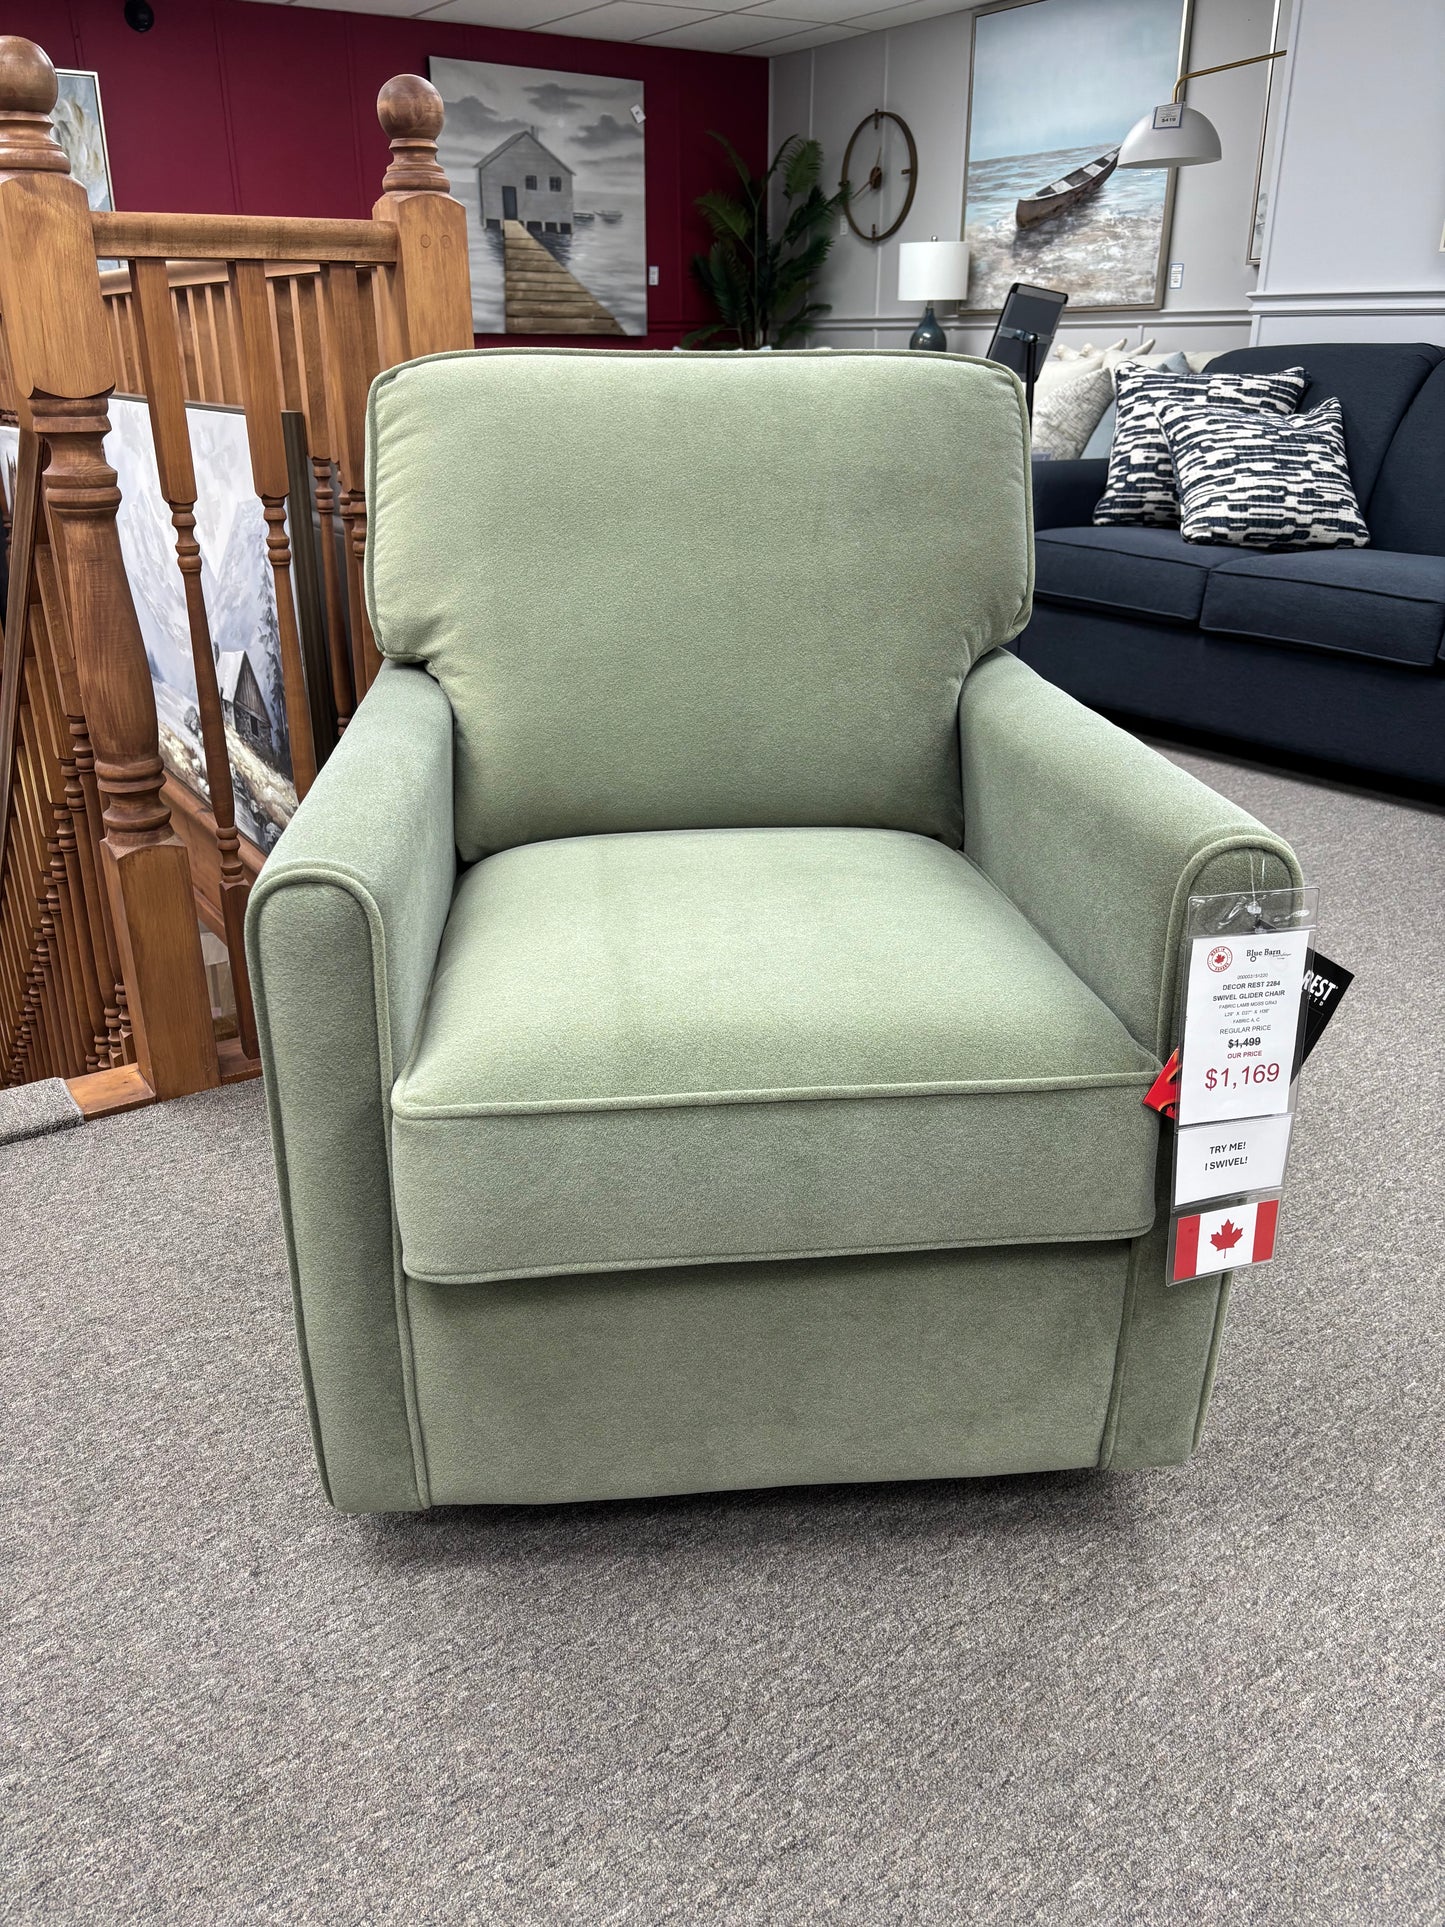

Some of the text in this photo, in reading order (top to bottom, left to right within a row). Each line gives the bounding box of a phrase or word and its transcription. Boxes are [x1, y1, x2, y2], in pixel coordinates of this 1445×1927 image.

[1246, 949, 1263, 962] Blue
[1264, 948, 1281, 956] Barn
[1222, 982, 1246, 991] DECOR
[1247, 981, 1265, 989] REST
[1212, 990, 1286, 1002] SWIVEL GLIDER CHAIR
[1220, 1026, 1250, 1035] REGULAR
[1228, 1036, 1261, 1049] $1,499
[1227, 1050, 1262, 1060] OUR PRICE
[1204, 1062, 1280, 1092] $1,169
[1209, 1142, 1247, 1155] TRY ME!
[1209, 1156, 1248, 1170] SWIVEL!
